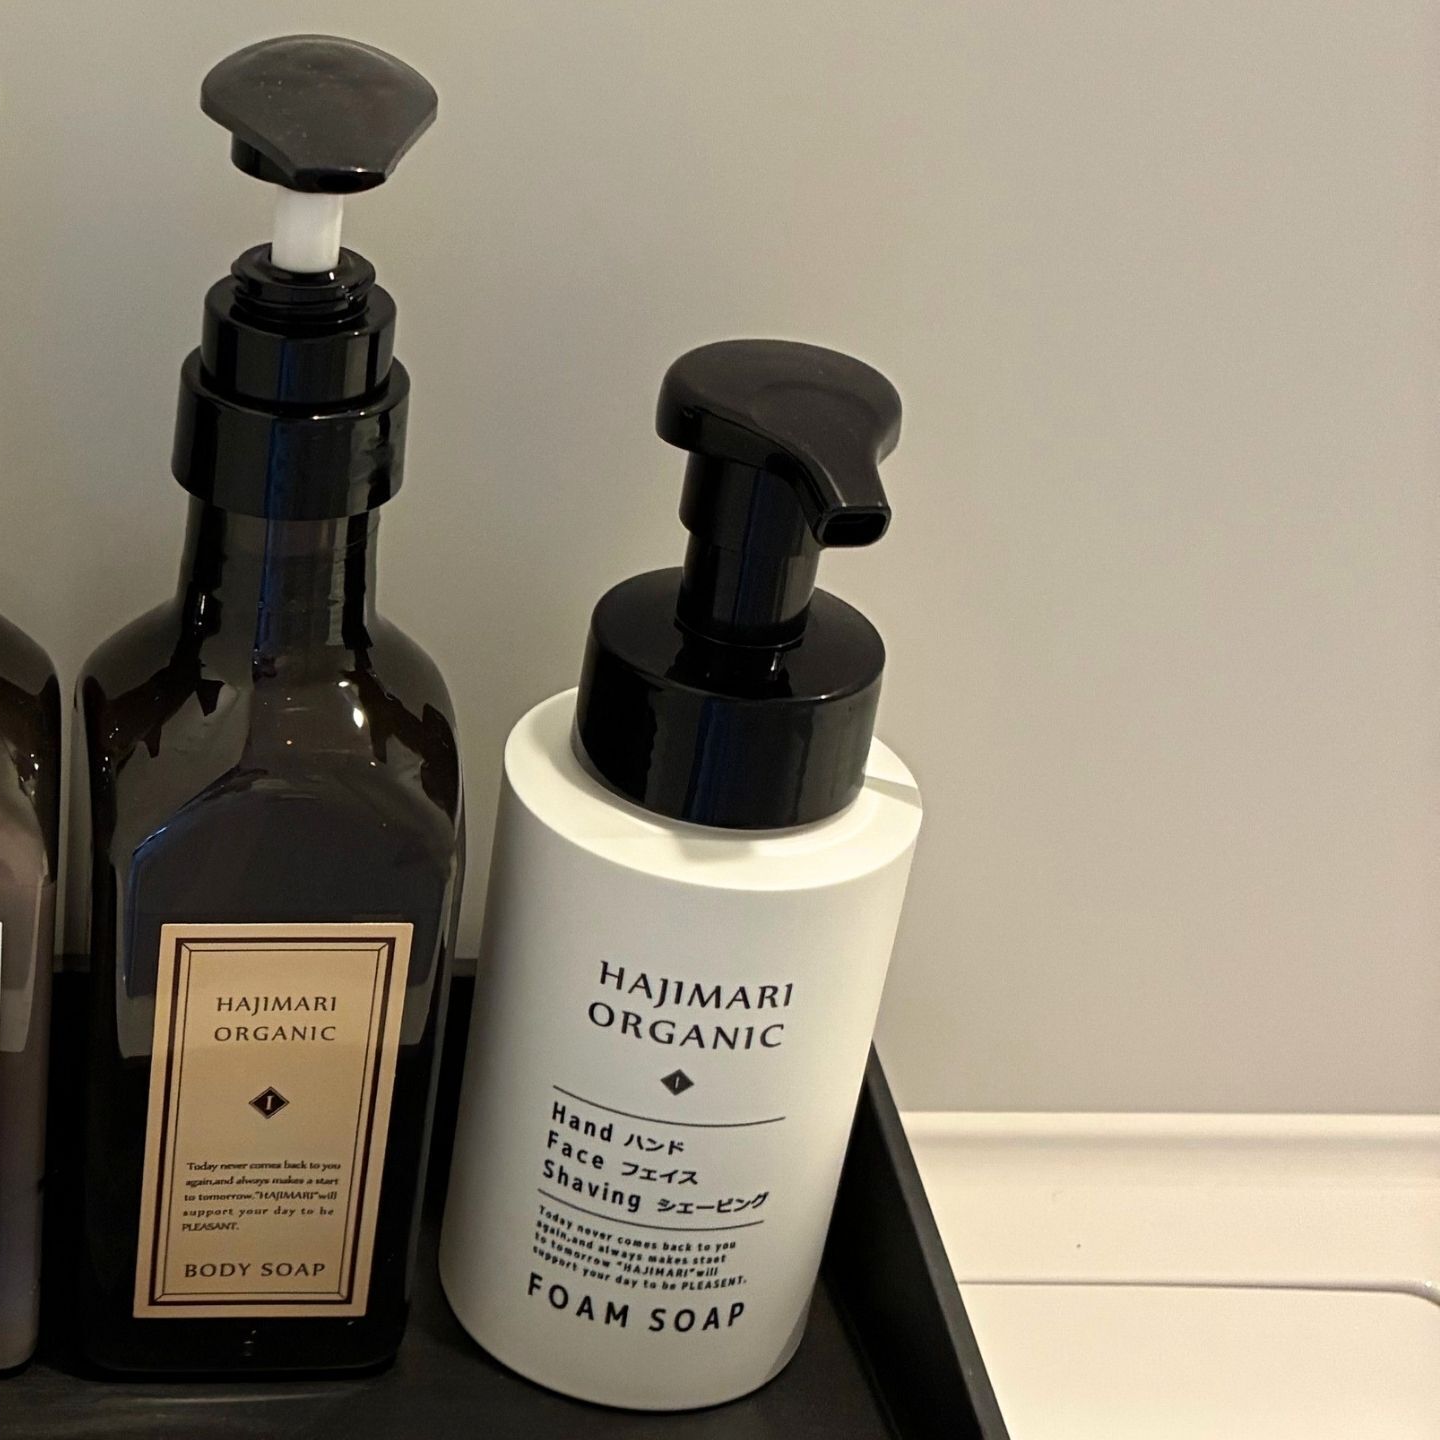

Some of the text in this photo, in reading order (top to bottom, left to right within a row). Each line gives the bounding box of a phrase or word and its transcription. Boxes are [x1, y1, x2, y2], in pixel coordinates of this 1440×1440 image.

[599, 960, 794, 1010] HAJIMARI
[216, 996, 337, 1016] HAJIMARI
[588, 1002, 785, 1050] ORGANIC
[214, 1026, 337, 1041] ORGANIC
[552, 1101, 685, 1156] Hand ハンド
[187, 1162, 218, 1172] Today
[284, 1160, 307, 1169] back
[322, 1163, 341, 1171] you
[547, 1130, 698, 1185] Face フェイス
[236, 1176, 270, 1187] always
[272, 1176, 304, 1184] makes
[542, 1159, 769, 1214] Shaving シェービング
[183, 1208, 234, 1217] support
[239, 1208, 269, 1217] your
[274, 1206, 296, 1216] day
[320, 1206, 334, 1215] be
[539, 1204, 736, 1252] Today never comes back to you
[533, 1245, 577, 1271] support
[583, 1268, 610, 1281] your
[615, 1275, 638, 1288] day
[643, 1280, 656, 1289] to
[662, 1281, 676, 1290] be
[535, 1232, 547, 1244] to
[551, 1240, 610, 1267] tomorrow
[598, 1245, 643, 1261] always
[648, 1255, 688, 1264] makes
[185, 1262, 326, 1278] BODY SOAP
[527, 1271, 745, 1333] FOAM SOAP
